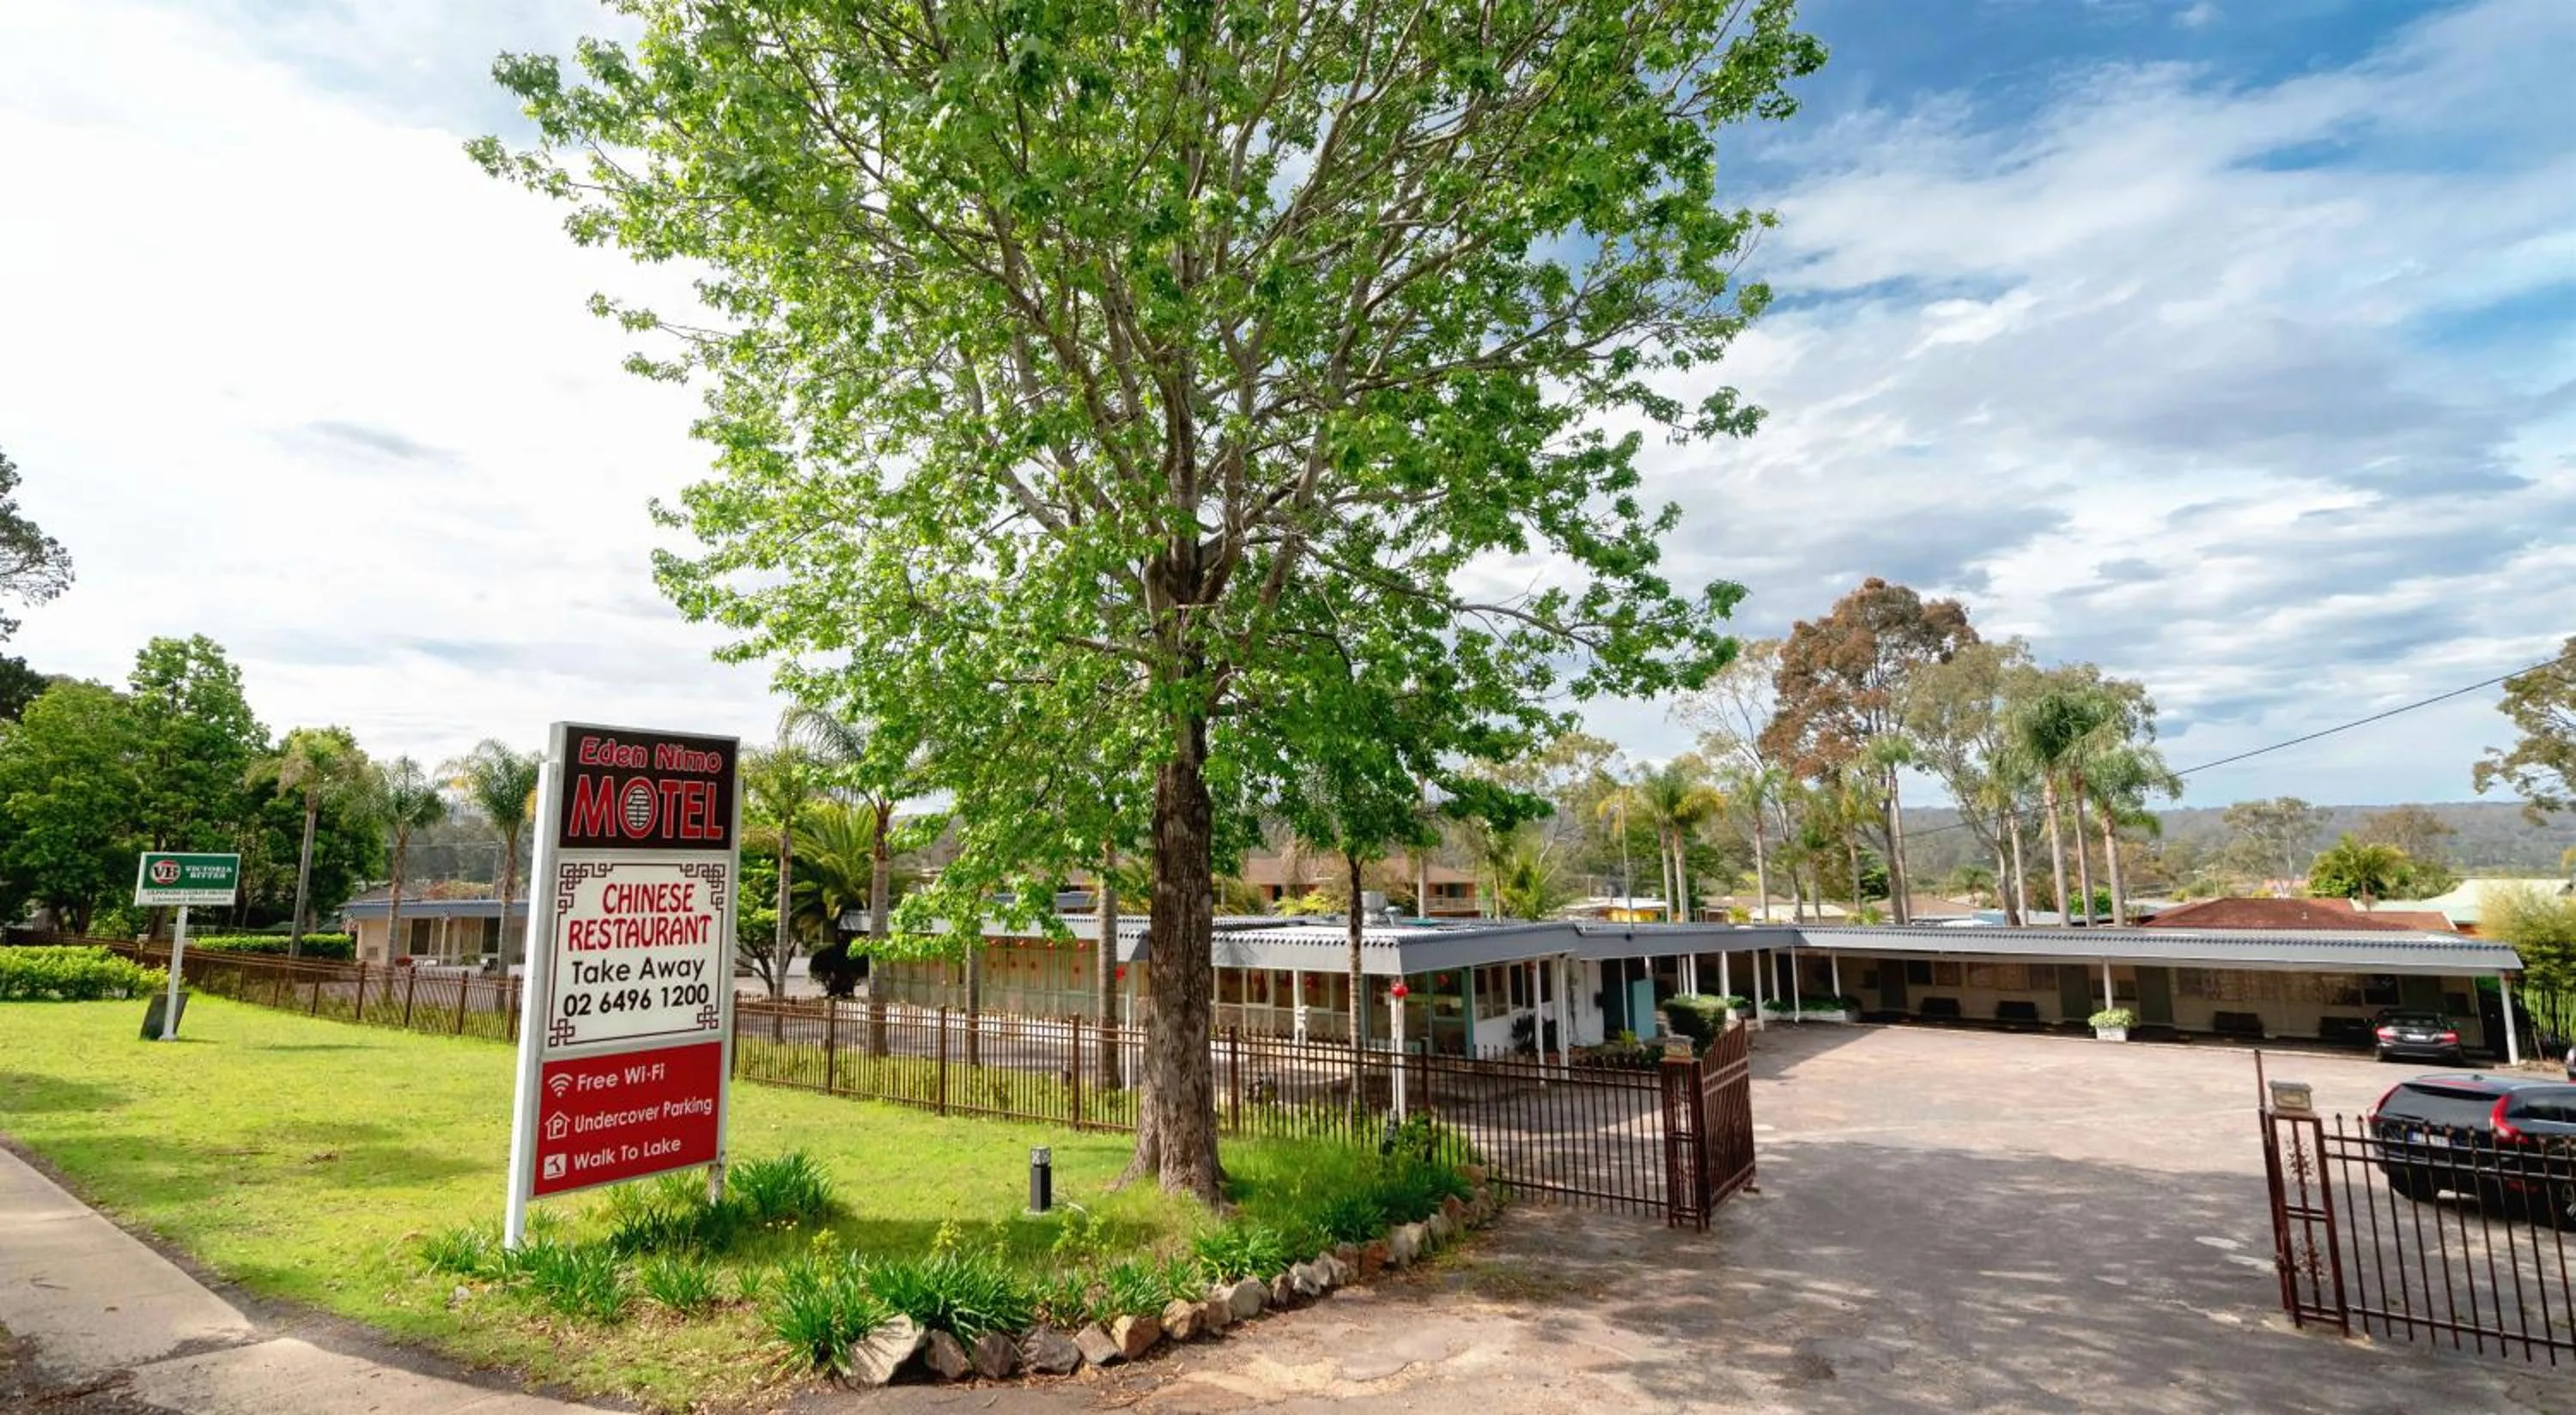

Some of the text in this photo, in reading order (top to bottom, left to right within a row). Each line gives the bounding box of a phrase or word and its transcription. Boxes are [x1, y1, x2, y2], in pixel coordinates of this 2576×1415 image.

[579, 736, 722, 773] Eden Nimo
[568, 774, 724, 841] MOTEL
[603, 884, 695, 914] CHINESE
[568, 915, 712, 951] RESTAURANT
[572, 956, 706, 985] Take Away
[563, 983, 709, 1017] 02 6496 1200
[576, 1062, 665, 1091] Free Wi-Fi
[574, 1097, 714, 1133] Undercover Parking
[574, 1138, 681, 1170] Walk To Lake
